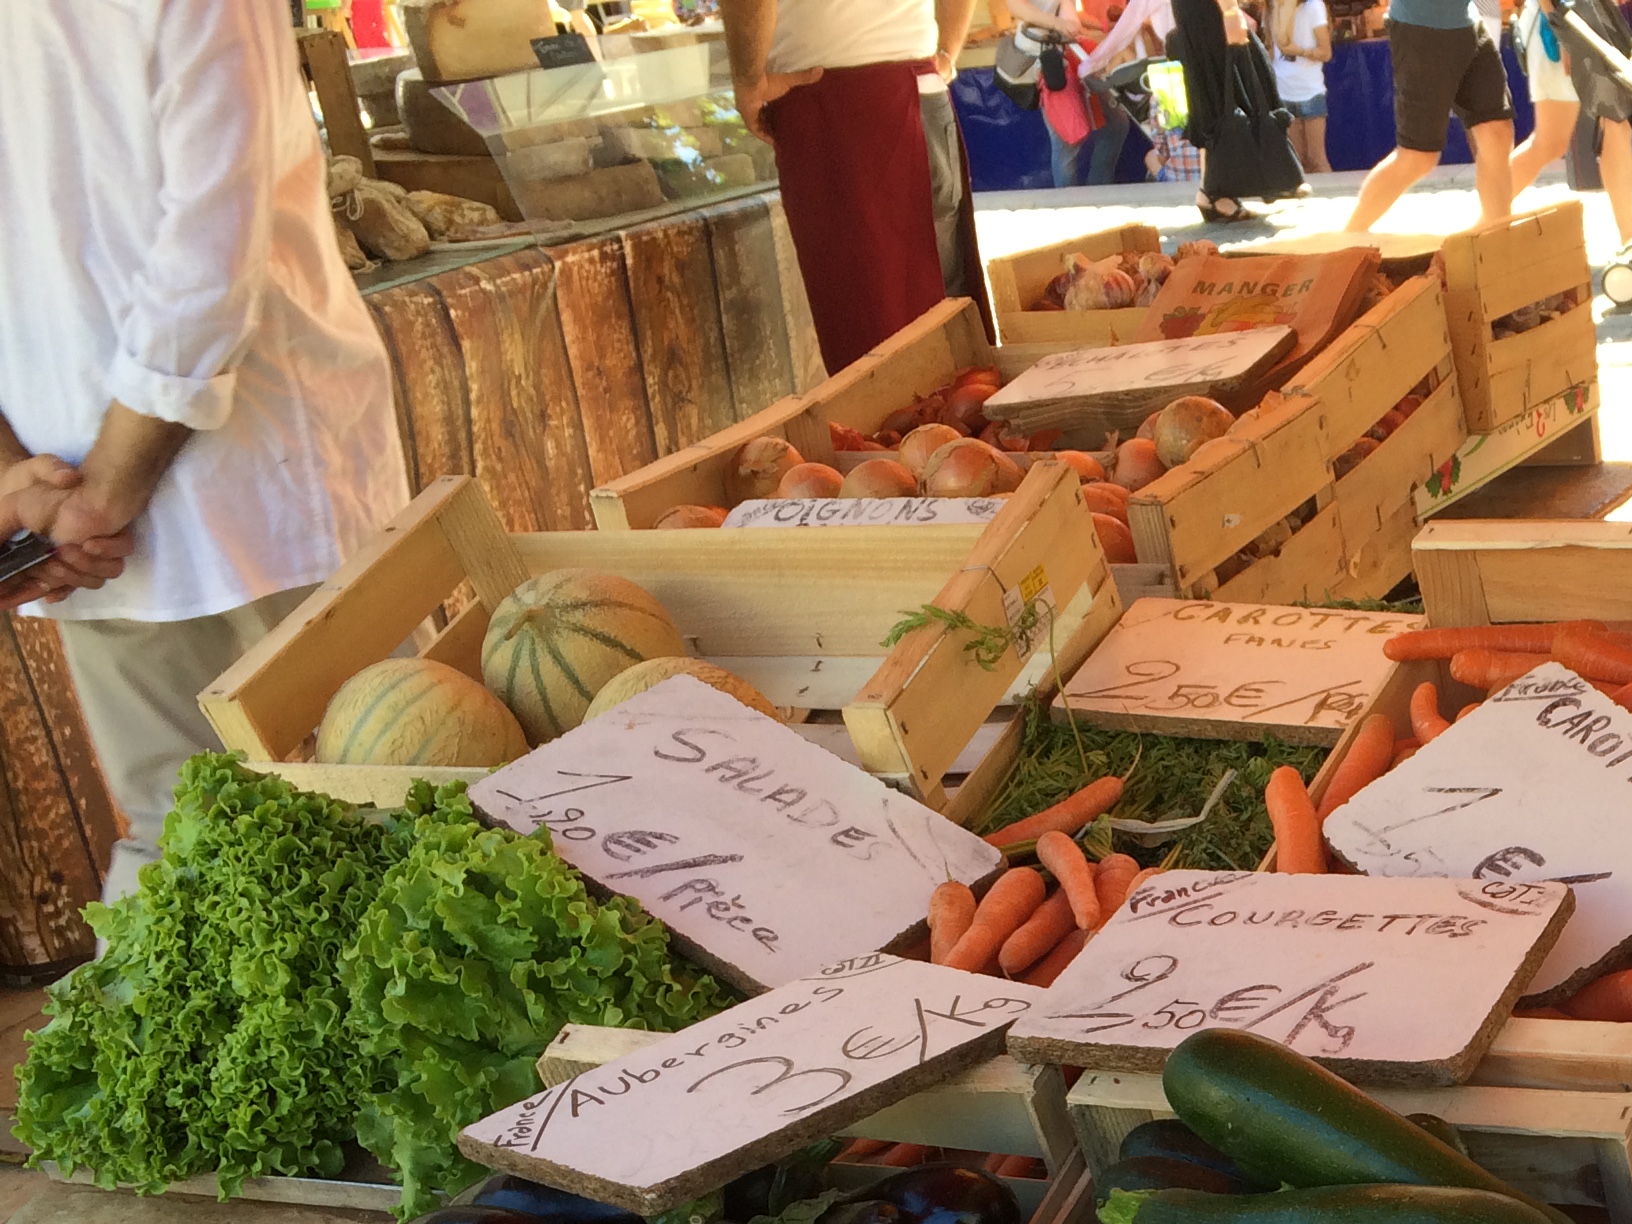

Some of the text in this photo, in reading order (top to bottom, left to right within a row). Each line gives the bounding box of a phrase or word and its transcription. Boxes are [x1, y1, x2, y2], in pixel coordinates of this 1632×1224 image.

[1191, 279, 1314, 298] MANGER
[653, 727, 893, 862] SALADES
[1168, 902, 1489, 940] COURGETTES
[493, 1090, 553, 1148] France
